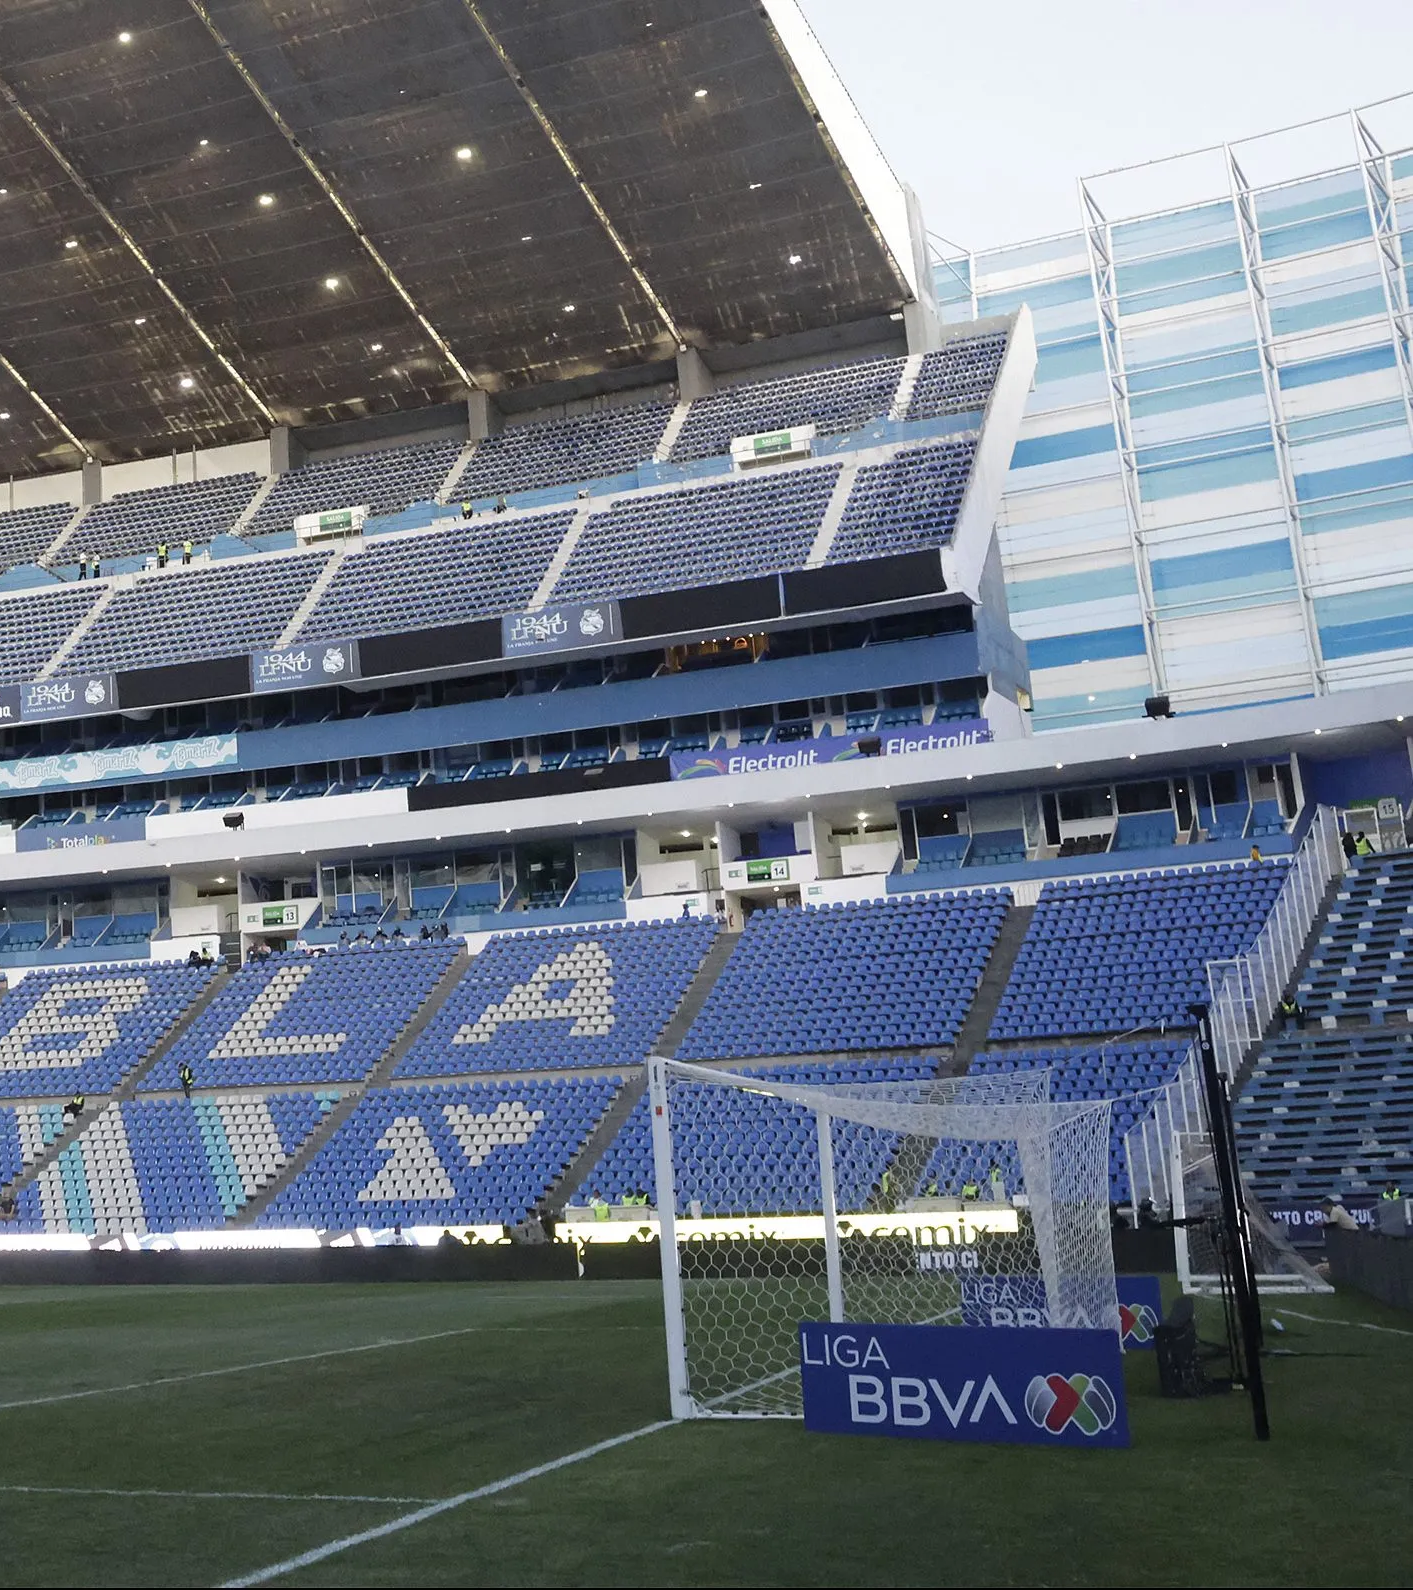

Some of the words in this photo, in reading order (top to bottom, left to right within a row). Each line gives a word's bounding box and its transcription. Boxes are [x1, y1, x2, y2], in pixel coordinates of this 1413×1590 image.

[515, 612, 562, 630] 1944
[263, 650, 306, 666] 1944
[259, 659, 312, 677] LFNU
[27, 690, 75, 706] LFNU
[31, 682, 70, 697] 1944
[887, 731, 981, 754] Electrolit
[728, 750, 818, 774] Electrolit
[1383, 804, 1394, 815] 15
[774, 867, 784, 876] 14
[286, 911, 294, 921] 13
[801, 1332, 890, 1370] LIGA
[848, 1373, 1018, 1429] BBVA
